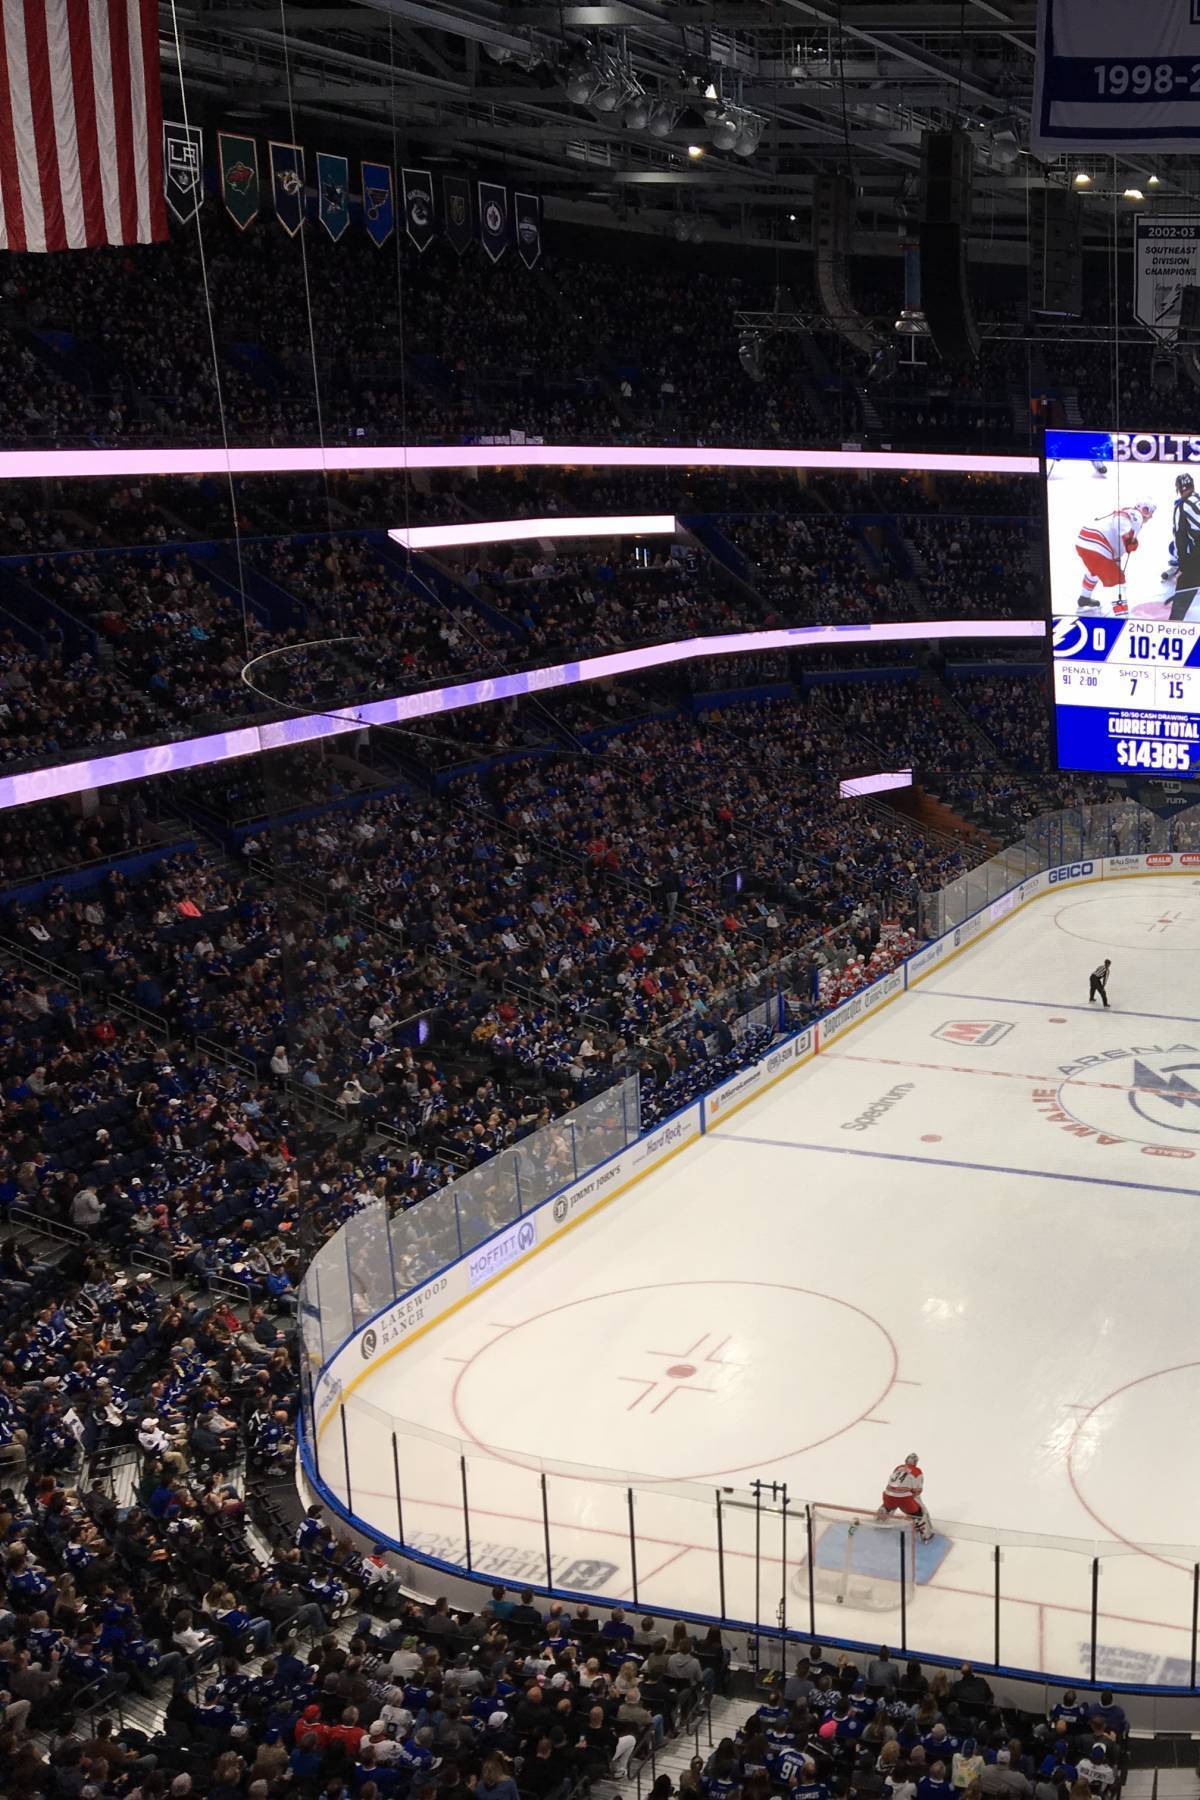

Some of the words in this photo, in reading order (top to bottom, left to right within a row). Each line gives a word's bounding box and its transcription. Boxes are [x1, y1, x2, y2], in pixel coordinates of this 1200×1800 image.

[1148, 227, 1195, 237] 2002-03
[1145, 246, 1197, 255] SOUTHEAST
[1152, 257, 1190, 265] DIVISION
[1145, 268, 1197, 276] CHAMPIONS
[1092, 627, 1106, 651] 0
[1129, 622, 1154, 635] 2ND
[1158, 624, 1195, 637] Period
[1128, 636, 1183, 662] 10:49
[1062, 666, 1102, 676] PENALTY
[1062, 674, 1072, 685] 91
[1119, 668, 1150, 679] SHOTS
[1161, 672, 1192, 682] SHOTS
[1130, 679, 1138, 697] 7
[1169, 681, 1184, 699] 15
[1140, 712, 1157, 720] CASH
[1158, 713, 1189, 722] DRAWING
[1108, 717, 1161, 737] CURRENT
[1164, 720, 1200, 740] TOTAL
[1116, 739, 1190, 771] $14385
[1048, 862, 1094, 884] GEICO
[1057, 1042, 1200, 1076] ARENA
[841, 1083, 910, 1132] Spectrum
[1031, 1087, 1126, 1146] AMALIE
[570, 1182, 595, 1208] JIMMY
[596, 1164, 621, 1190] JOHN'S
[469, 1234, 516, 1278] MOFFITT
[380, 1278, 448, 1331] LAKEWOOD
[381, 1309, 424, 1346] RANCH
